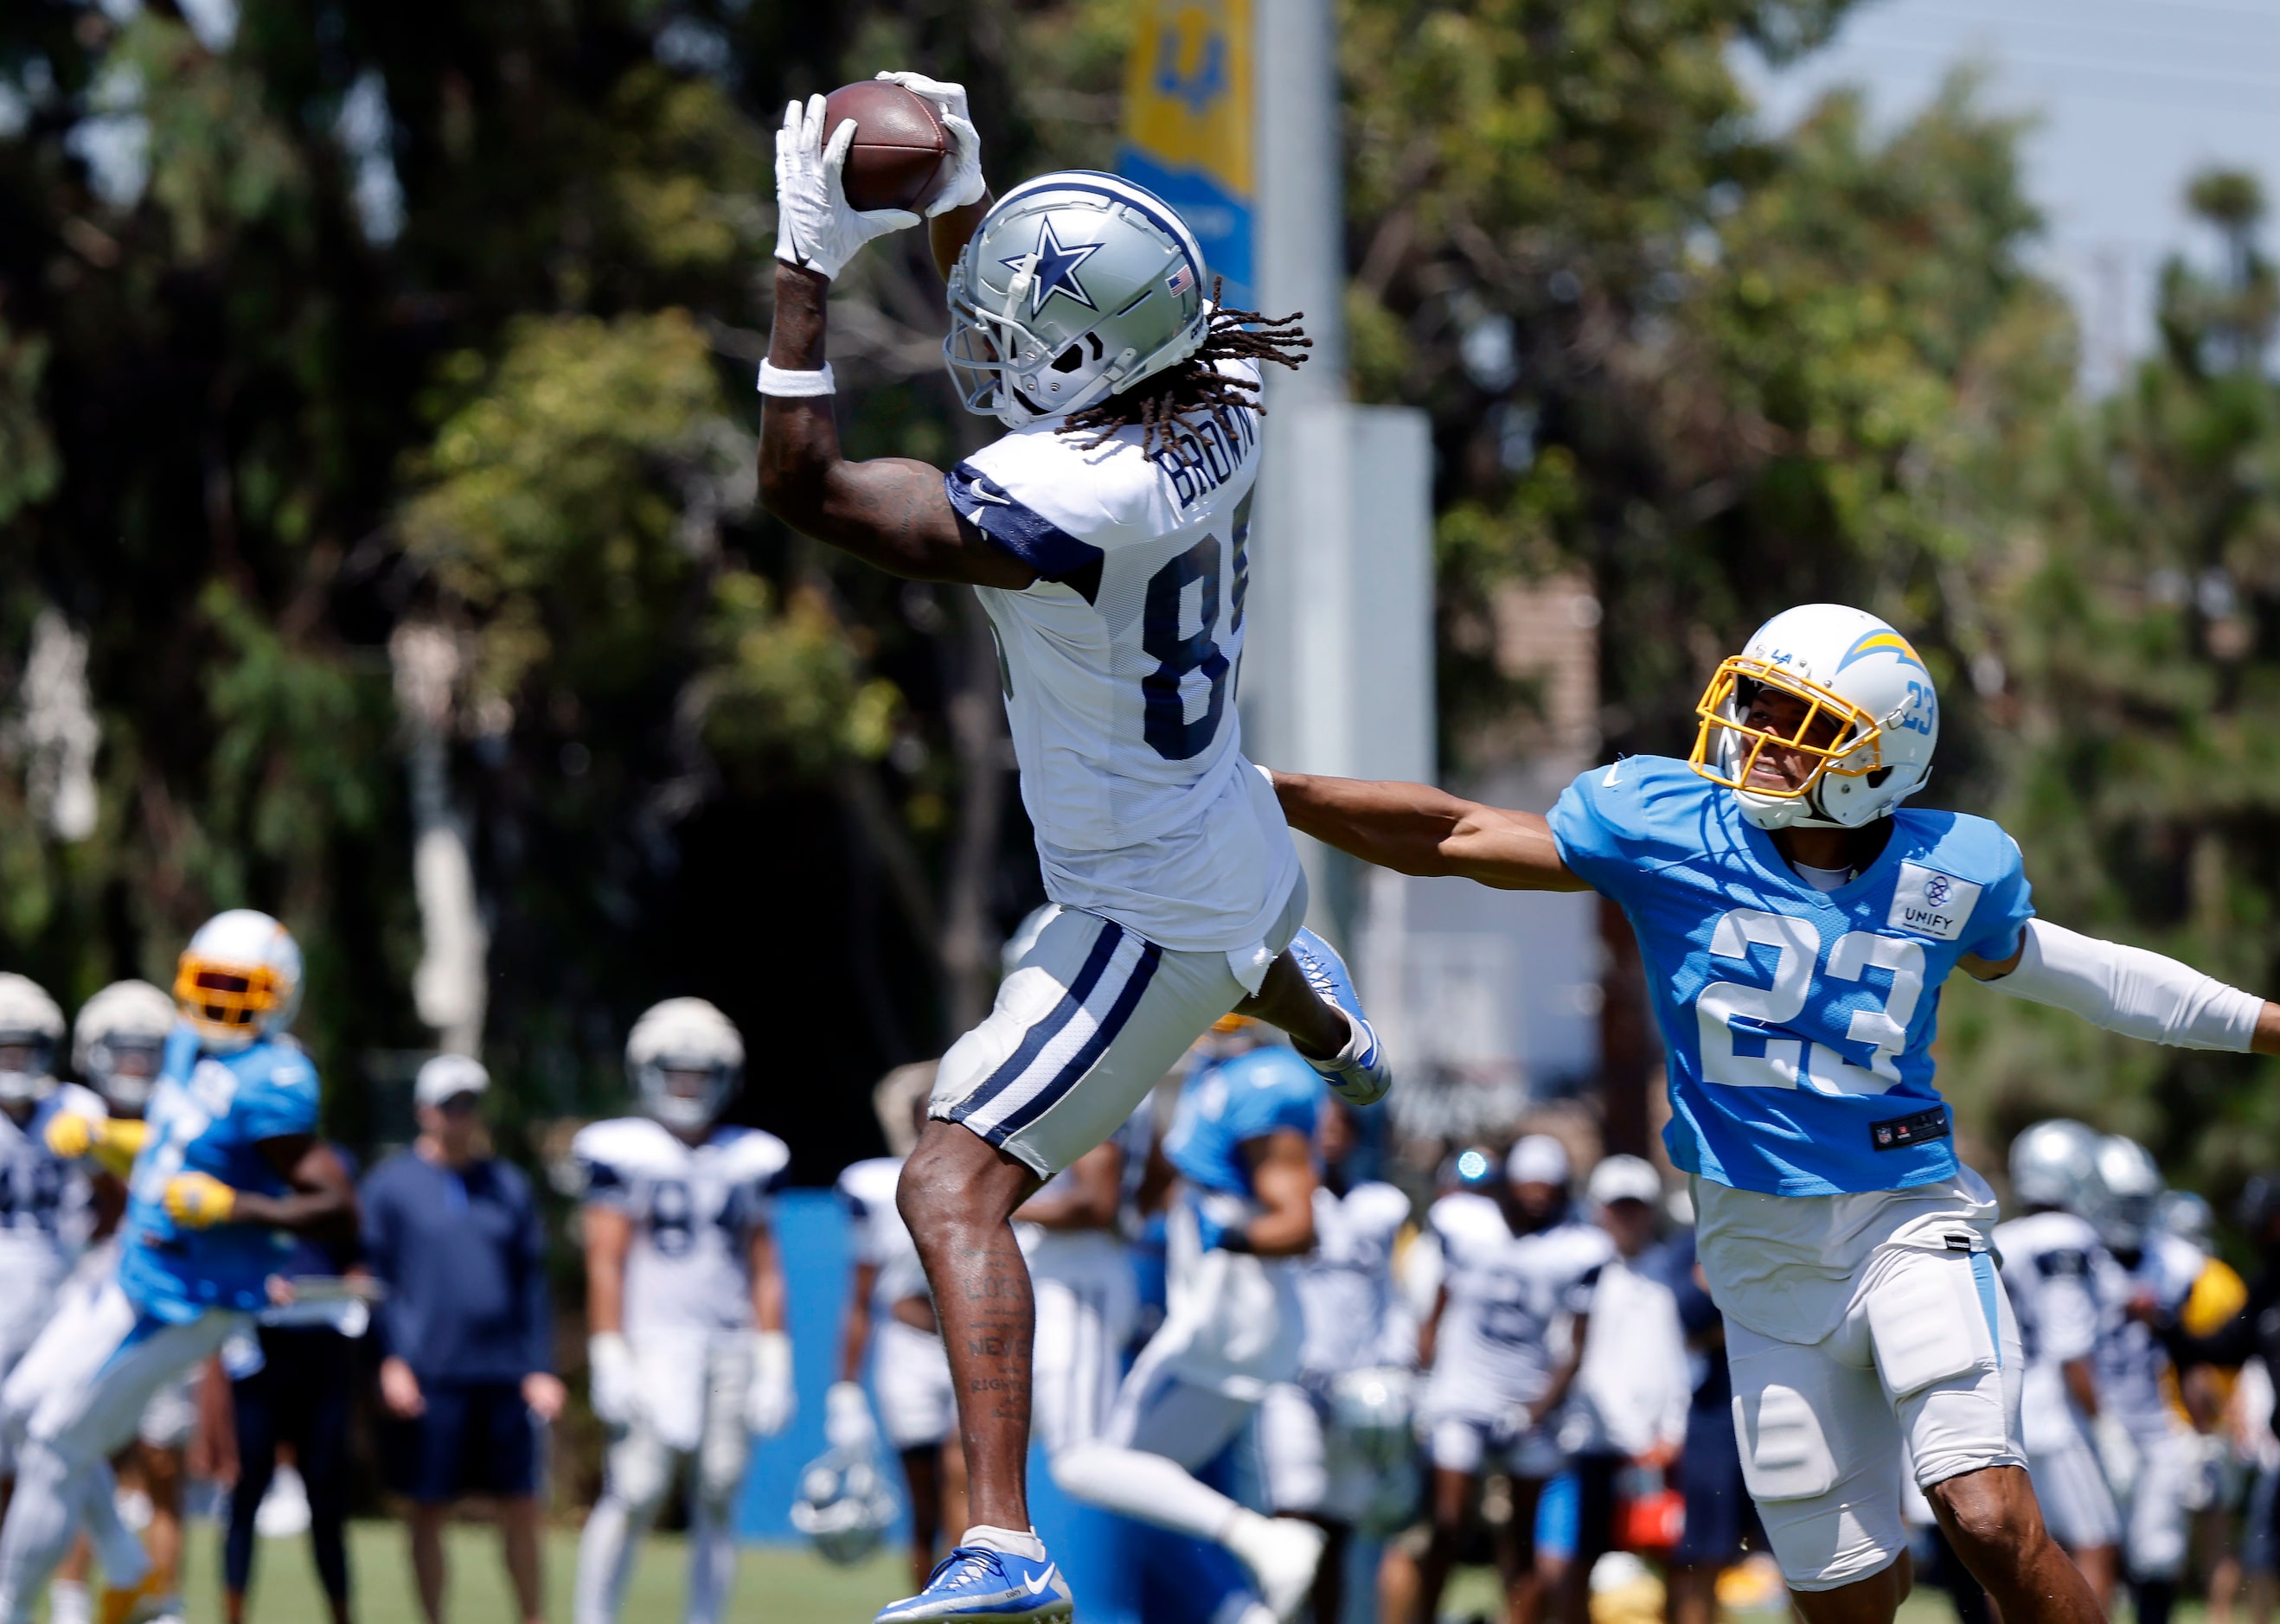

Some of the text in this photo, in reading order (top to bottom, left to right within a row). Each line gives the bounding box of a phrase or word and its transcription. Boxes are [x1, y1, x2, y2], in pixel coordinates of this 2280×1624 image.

[1151, 404, 1254, 508] BROWN
[1143, 478, 1255, 761] 8
[1902, 680, 1935, 736] 23
[1905, 907, 1954, 930] UNIFY
[1695, 907, 1926, 1096] 23
